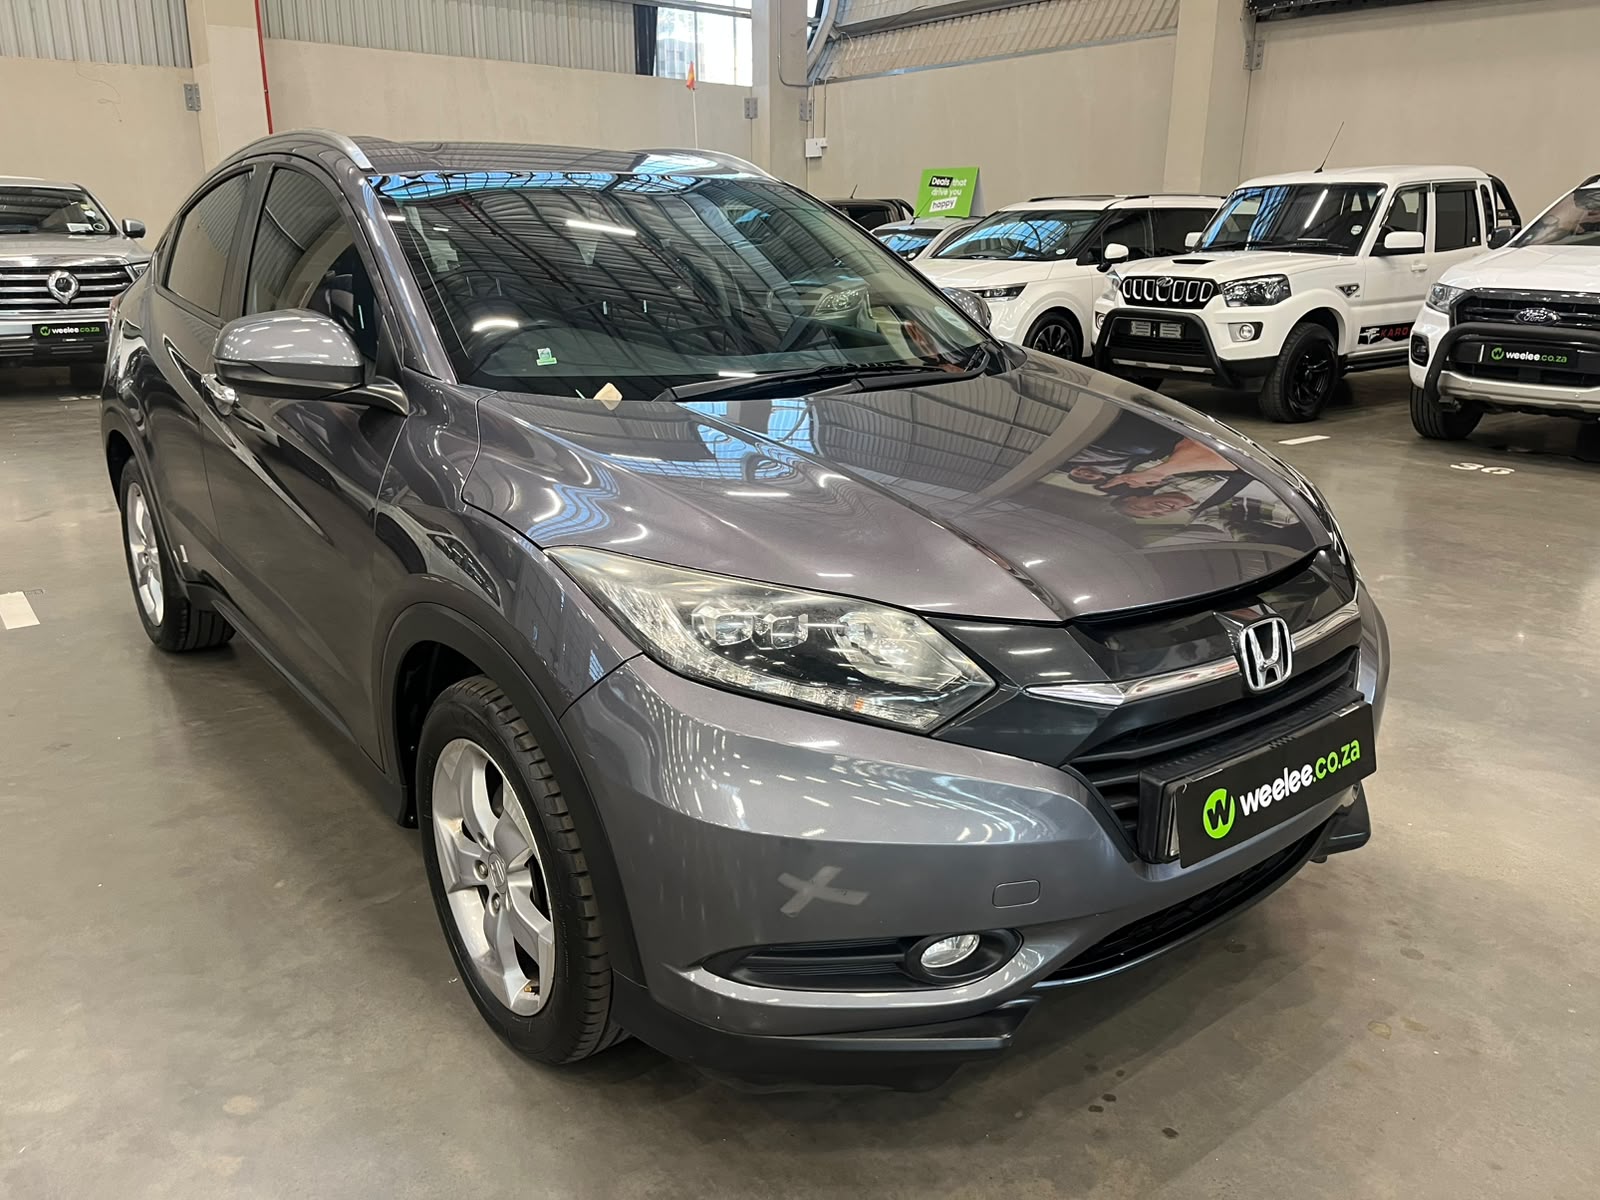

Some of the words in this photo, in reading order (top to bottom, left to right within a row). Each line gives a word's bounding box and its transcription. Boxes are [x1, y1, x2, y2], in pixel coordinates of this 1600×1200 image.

[931, 177, 951, 186] Deals
[951, 179, 967, 187] that
[931, 188, 948, 196] drive
[949, 189, 962, 198] you
[932, 199, 954, 209] happy
[1505, 351, 1568, 363] weelee.co.za
[1239, 739, 1361, 817] weelee.co.za
